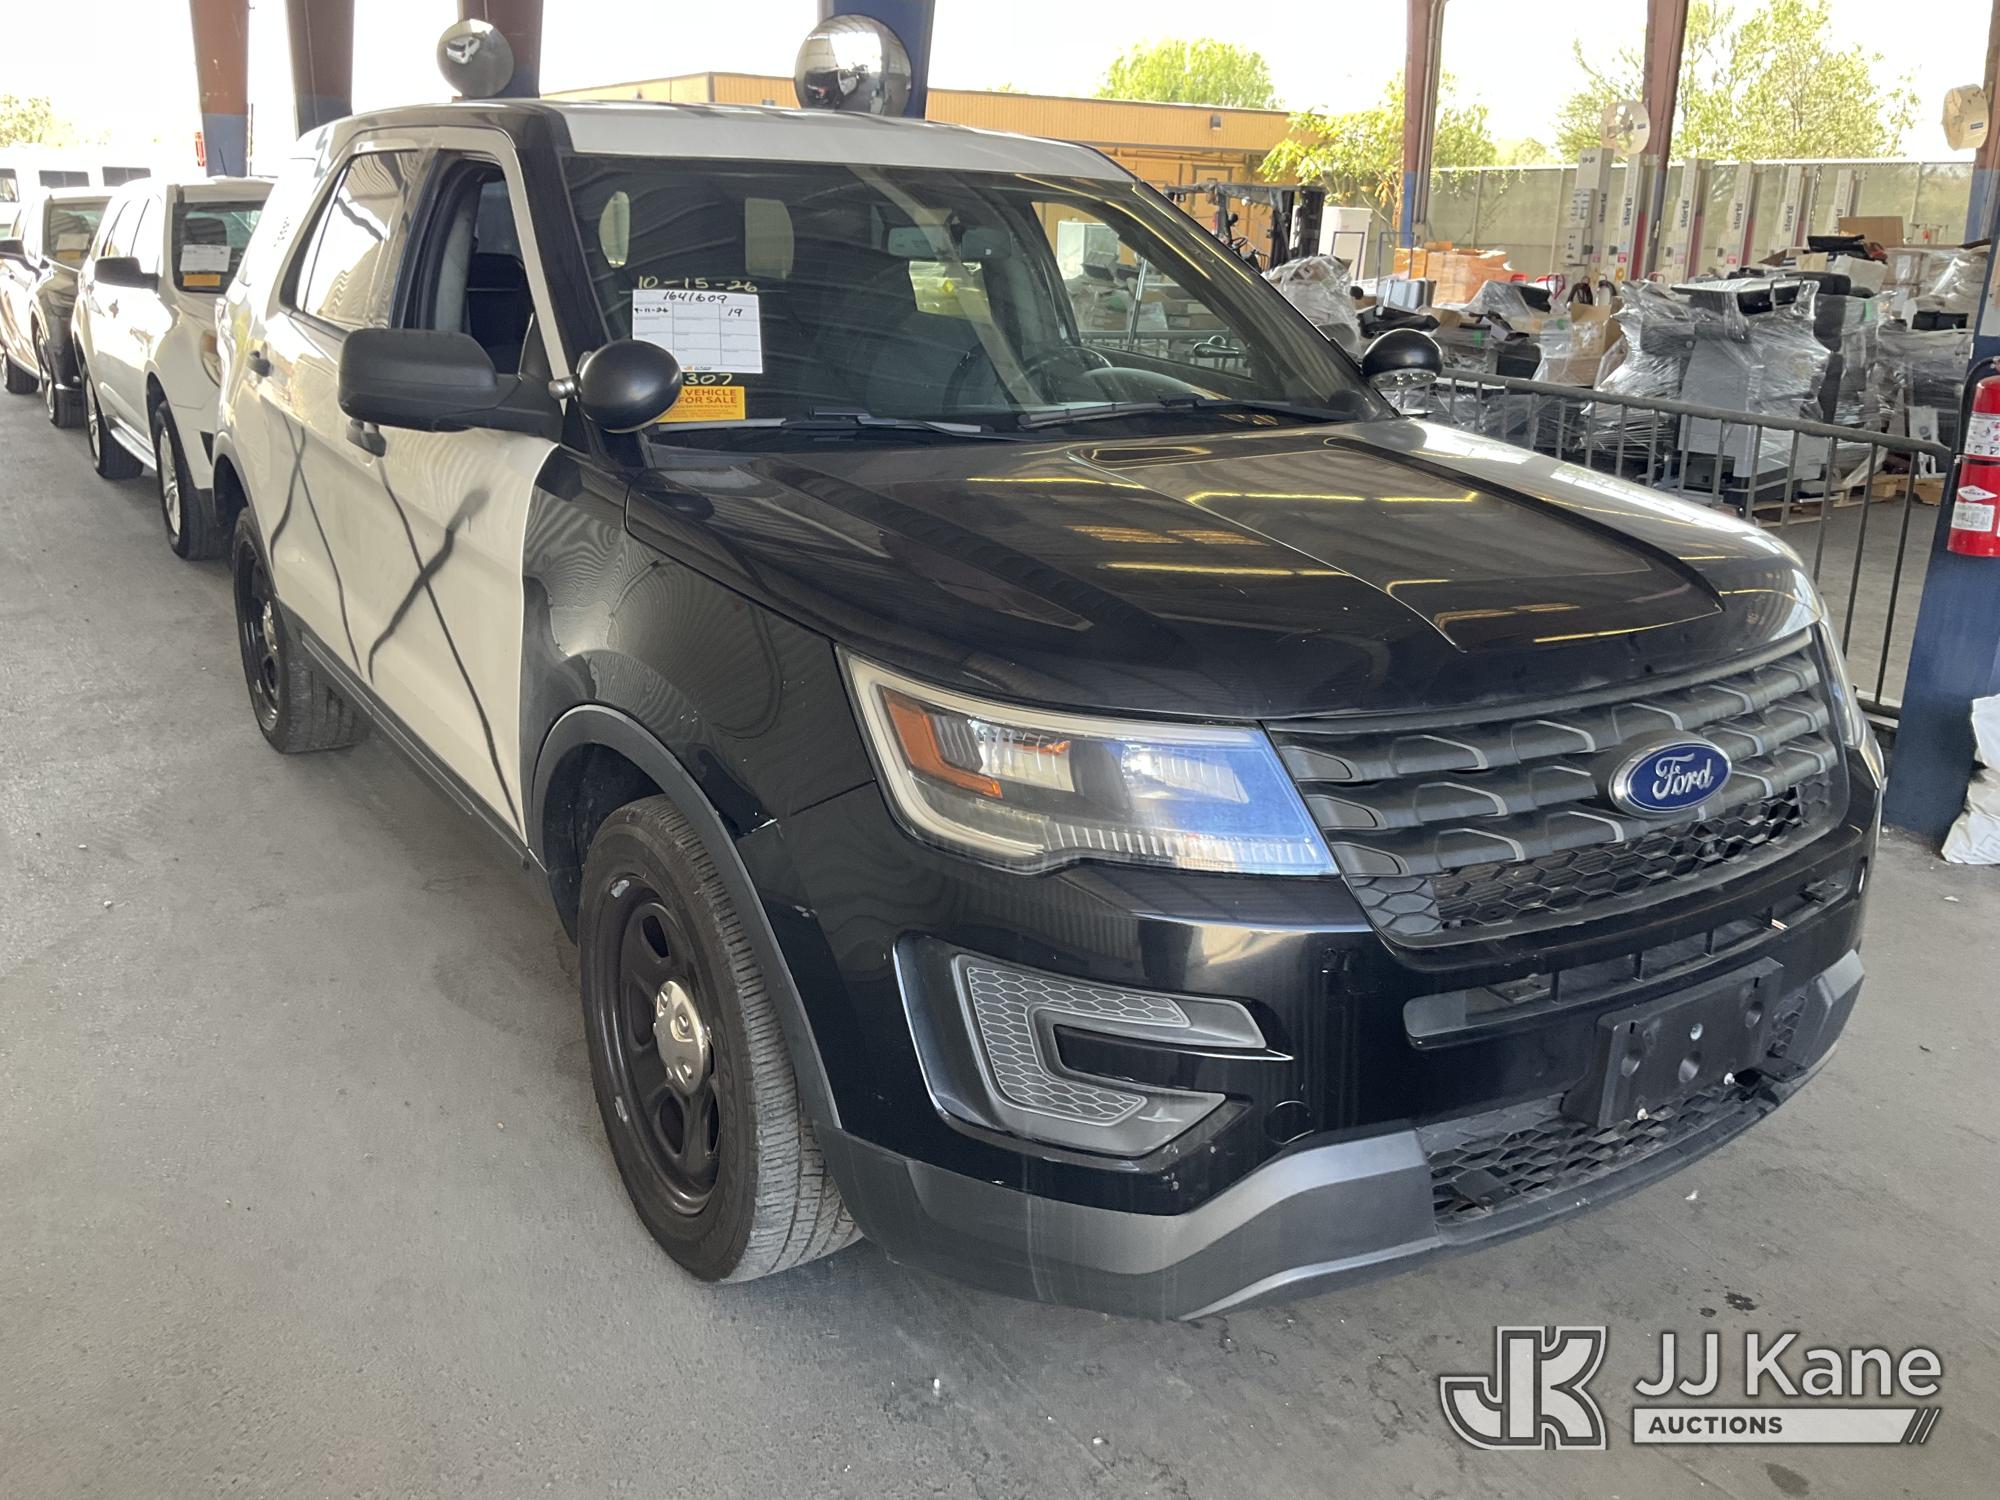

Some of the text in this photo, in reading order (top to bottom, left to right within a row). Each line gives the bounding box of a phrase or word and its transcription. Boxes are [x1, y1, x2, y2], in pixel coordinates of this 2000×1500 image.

[728, 308, 744, 317] 19
[685, 388, 737, 397] VEHICLE
[678, 396, 737, 404] FOR SALE
[1652, 752, 1714, 800] Ford
